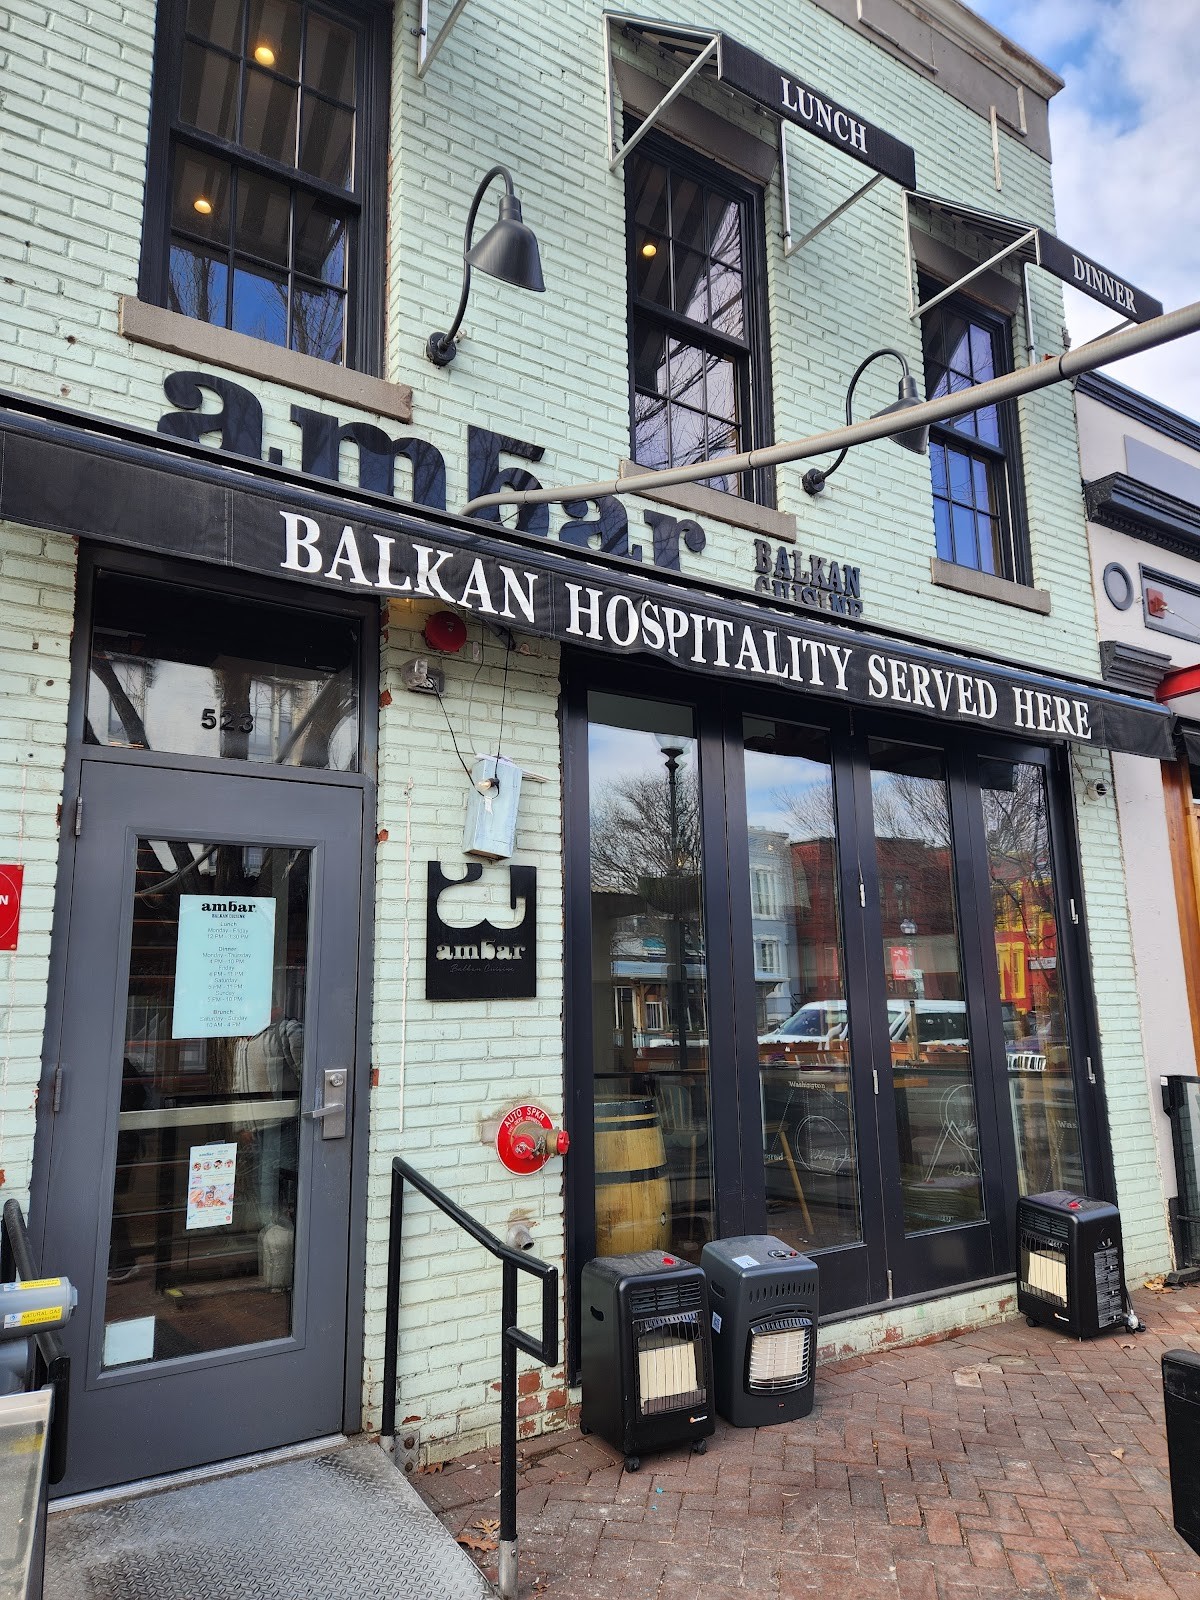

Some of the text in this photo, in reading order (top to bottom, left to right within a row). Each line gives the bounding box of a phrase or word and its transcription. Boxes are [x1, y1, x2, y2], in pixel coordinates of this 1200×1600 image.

[780, 76, 869, 155] LUNCH
[1071, 254, 1138, 314] DINNER
[754, 538, 861, 599] BALKAN
[278, 510, 1092, 740] BALKAN HOSPITALITY SERVED HERE
[201, 708, 254, 734] 523
[201, 900, 256, 913] ambar
[435, 939, 527, 961] ambar
[449, 961, 515, 973] Balkan Cuisine
[788, 1080, 826, 1089] Washington
[504, 1106, 546, 1128] AUTO SPKR
[21, 1309, 48, 1320] NATURAL
